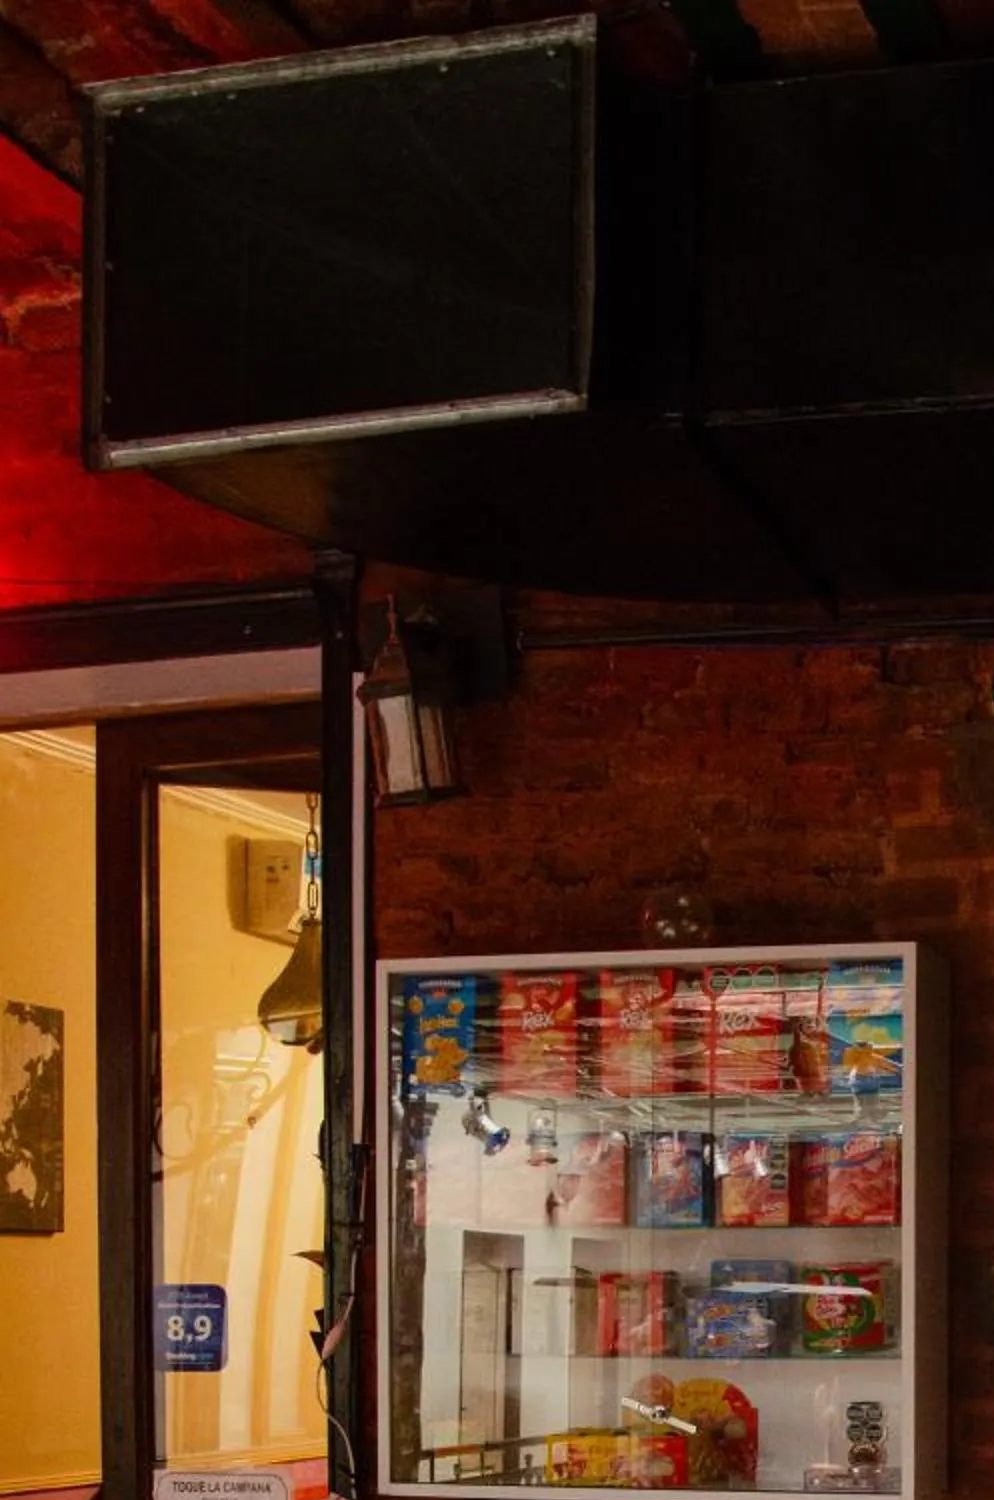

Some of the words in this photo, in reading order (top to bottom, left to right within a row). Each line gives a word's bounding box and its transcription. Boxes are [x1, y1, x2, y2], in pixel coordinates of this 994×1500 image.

[167, 1316, 212, 1343] 8,9
[172, 1481, 206, 1494] TOQUE
[208, 1481, 221, 1493] LA
